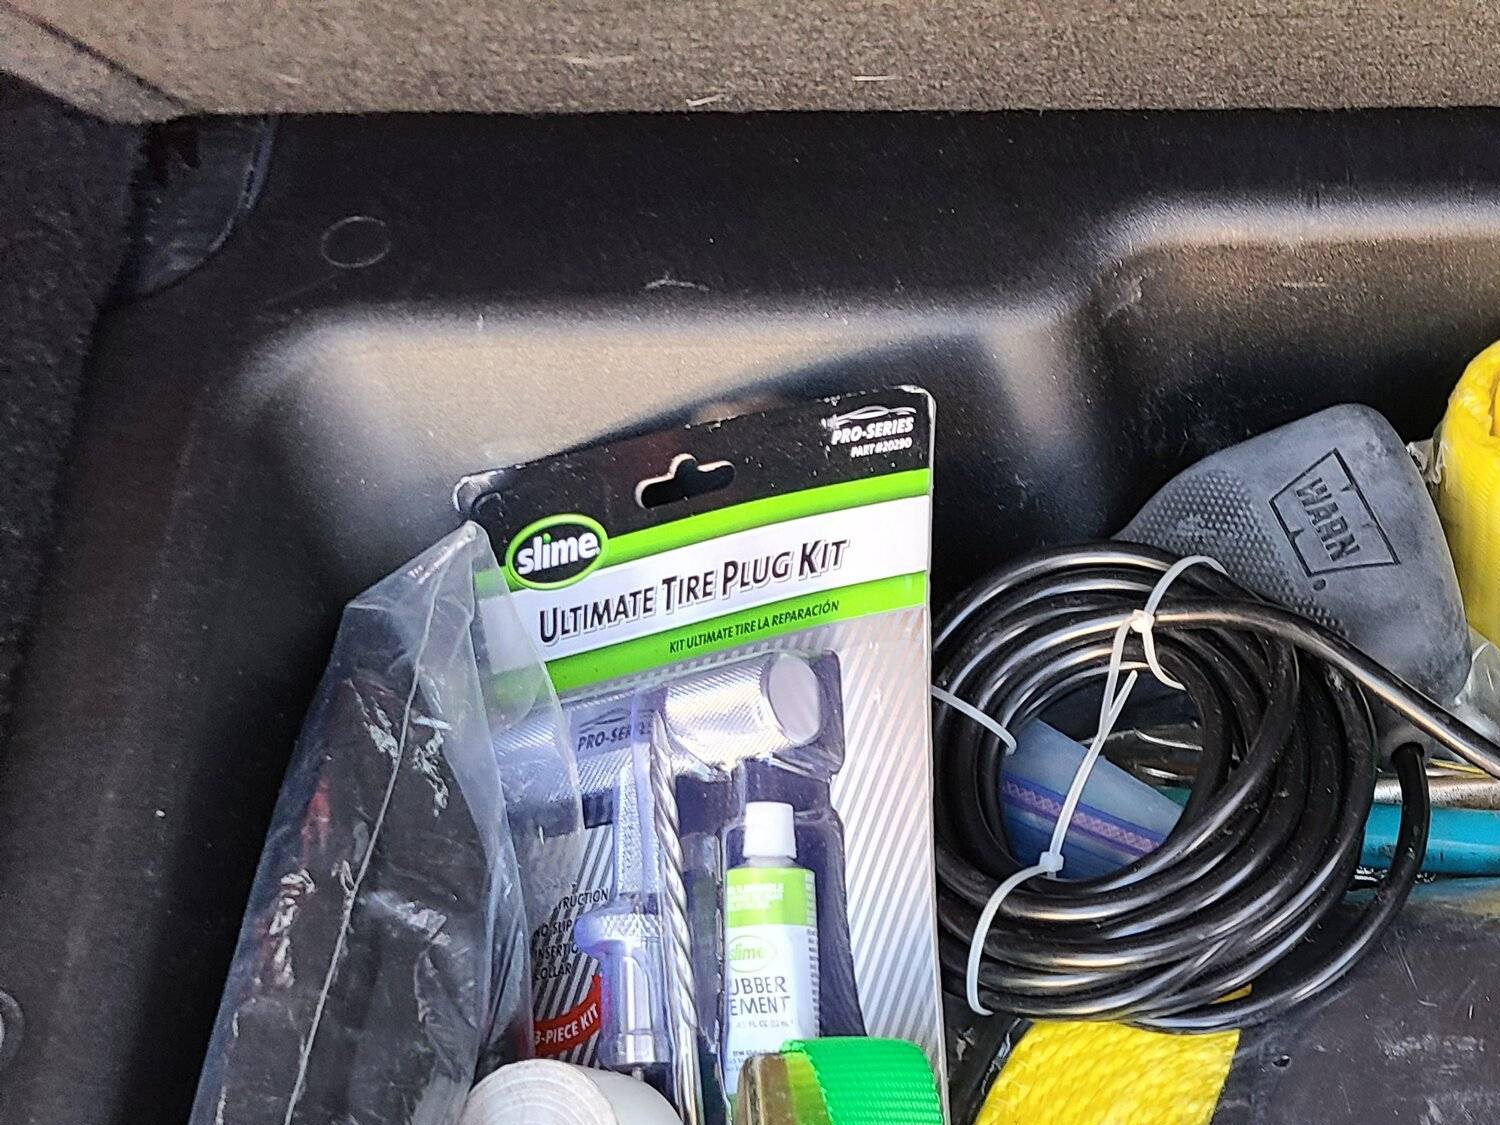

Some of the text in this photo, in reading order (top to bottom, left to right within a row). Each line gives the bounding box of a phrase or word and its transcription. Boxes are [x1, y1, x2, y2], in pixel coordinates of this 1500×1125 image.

[831, 416, 915, 446] PRO-SERIES
[1296, 477, 1361, 562] WARN
[517, 531, 600, 576] slime
[540, 539, 849, 644] ULTIMATE TIRE PLUG KIT
[669, 600, 840, 653] KIT ULTIMATE TIRE LA REPARACIÓN
[551, 918, 573, 935] SLIP
[732, 975, 788, 996] UBBER
[579, 1003, 599, 1031] KIT
[730, 996, 791, 1016] EMENT
